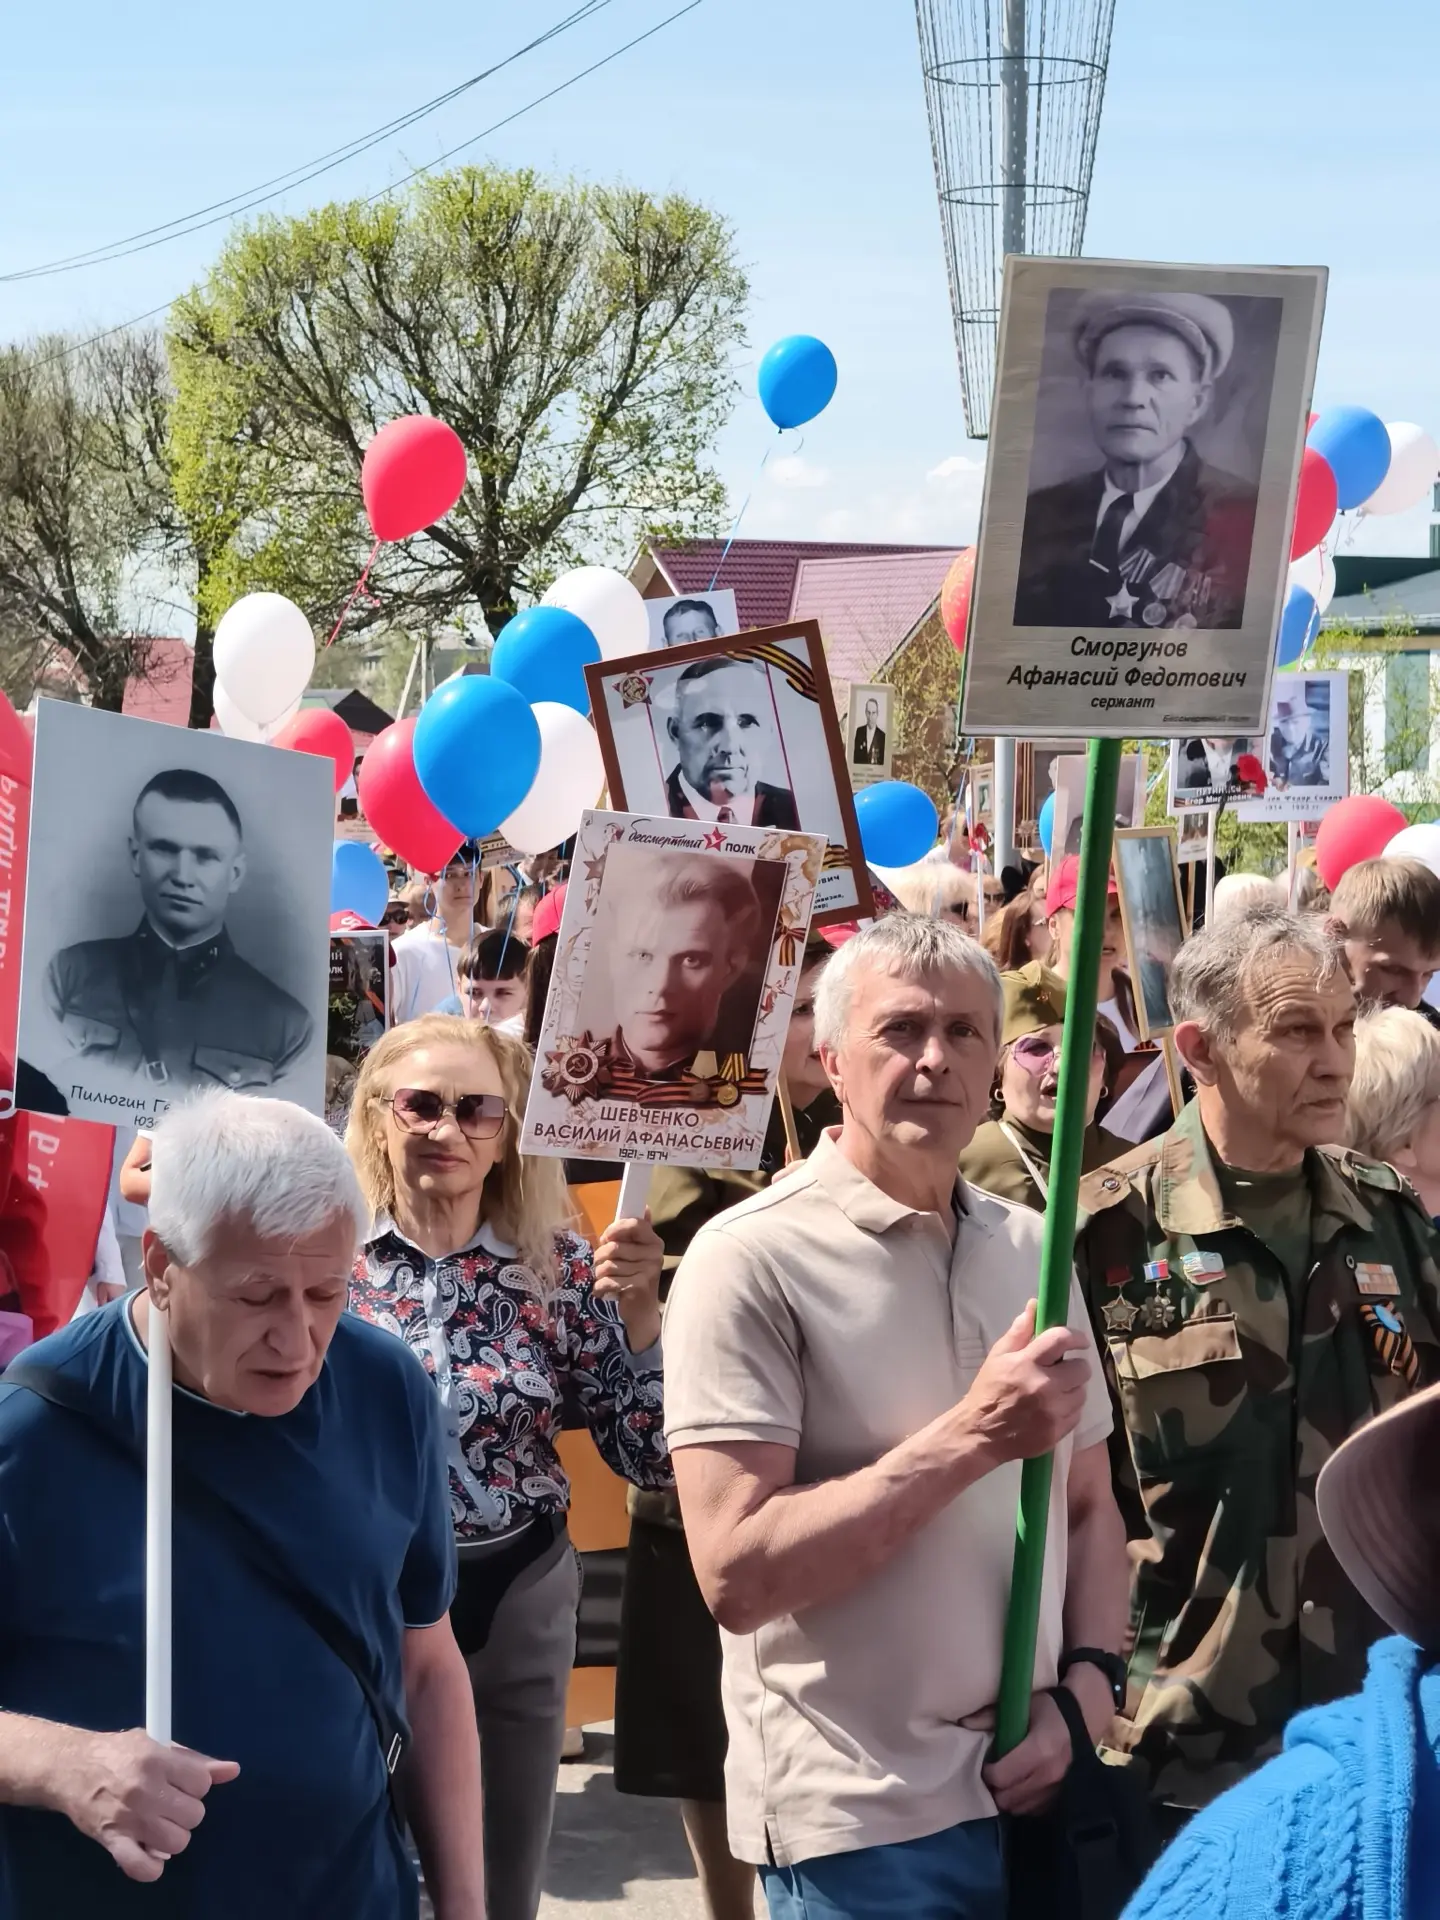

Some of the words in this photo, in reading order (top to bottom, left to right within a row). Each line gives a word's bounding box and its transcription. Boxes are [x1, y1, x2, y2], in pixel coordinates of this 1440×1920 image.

[1070, 636, 1188, 662] Сморгунов
[1007, 665, 1118, 690] Афанасий
[1124, 667, 1247, 688] Федотович
[1091, 697, 1155, 711] сержант
[71, 1085, 146, 1110] Пилюгин
[600, 1106, 699, 1128] ШЕВЧЕНКО
[534, 1122, 621, 1143] ВАСИЛИЙ
[626, 1130, 755, 1152] АФАНАСЬЕВИЧ
[618, 1148, 637, 1159] 1921
[646, 1150, 669, 1161] 1974
